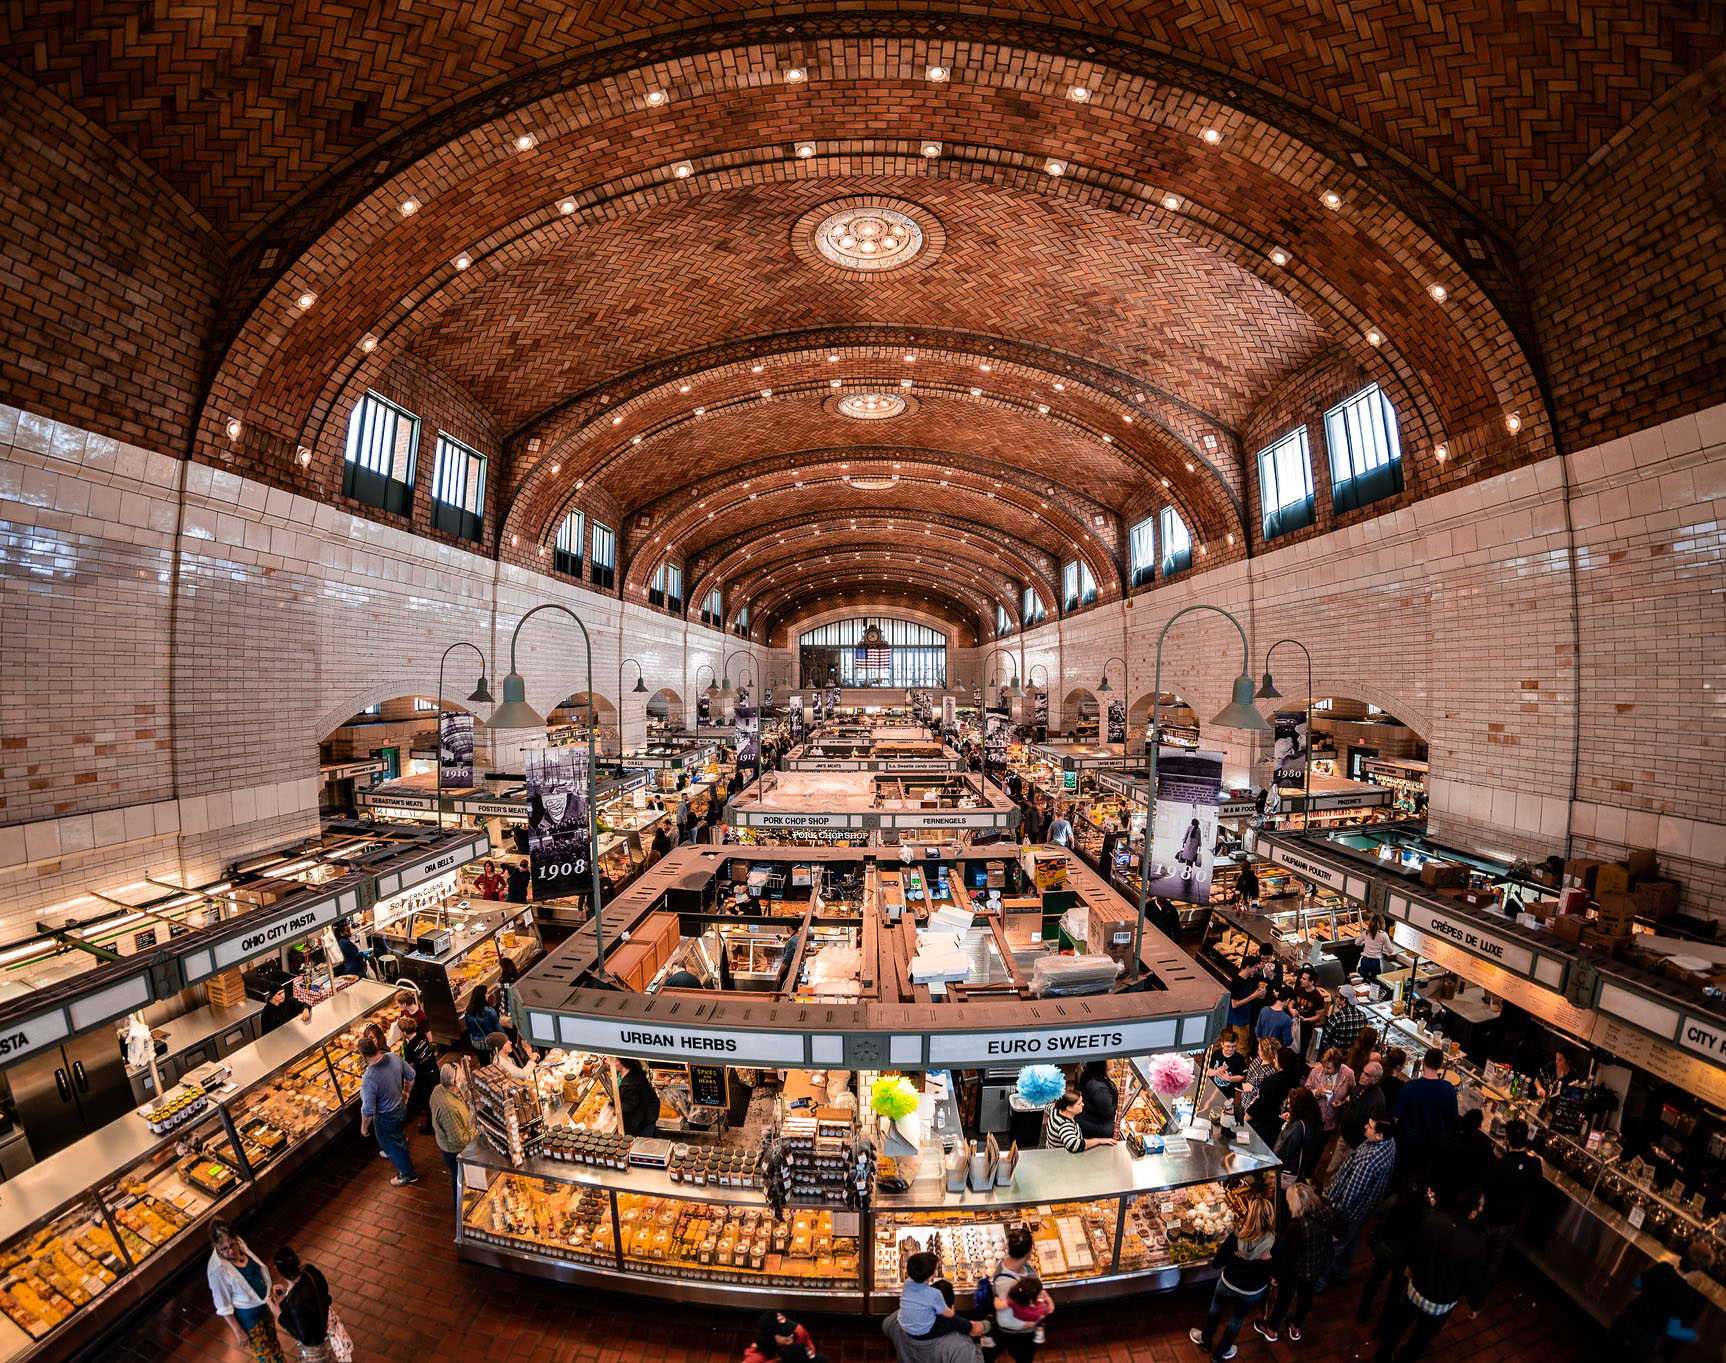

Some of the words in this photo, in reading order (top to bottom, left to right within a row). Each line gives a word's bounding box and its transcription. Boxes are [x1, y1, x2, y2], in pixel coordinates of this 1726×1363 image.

[739, 753, 756, 761] 1917
[444, 769, 468, 778] 1910
[1277, 769, 1302, 779] 1980
[371, 798, 405, 806] SEBASTIAN'S
[478, 805, 507, 813] FOSTER'S
[763, 816, 783, 825] PORK
[784, 816, 806, 825] CHOP
[807, 817, 829, 826] SHOP
[922, 817, 966, 825] FERNENGELS
[792, 831, 818, 840] PORK
[818, 831, 844, 840] CHOP
[844, 831, 869, 840] SHOP
[424, 863, 437, 874] ORA
[437, 855, 455, 869] BELL'S
[537, 859, 586, 880] 1908
[1152, 863, 1207, 883] 1980
[1282, 855, 1308, 870] KAUFMANN
[1309, 866, 1332, 880] POULTRY
[241, 933, 265, 951] OHIO
[267, 923, 288, 941] CITY
[289, 912, 316, 931] PASTA
[1431, 919, 1463, 941] CRÊPES
[1465, 933, 1478, 947] DE
[1480, 939, 1504, 959] LUXE
[0, 1032, 29, 1055] STA
[620, 1030, 674, 1047] URBAN
[680, 1035, 737, 1052] HERBS
[987, 1038, 1042, 1055] EURO
[1046, 1032, 1123, 1052] SWEETS
[1687, 1027, 1717, 1048] CITY
